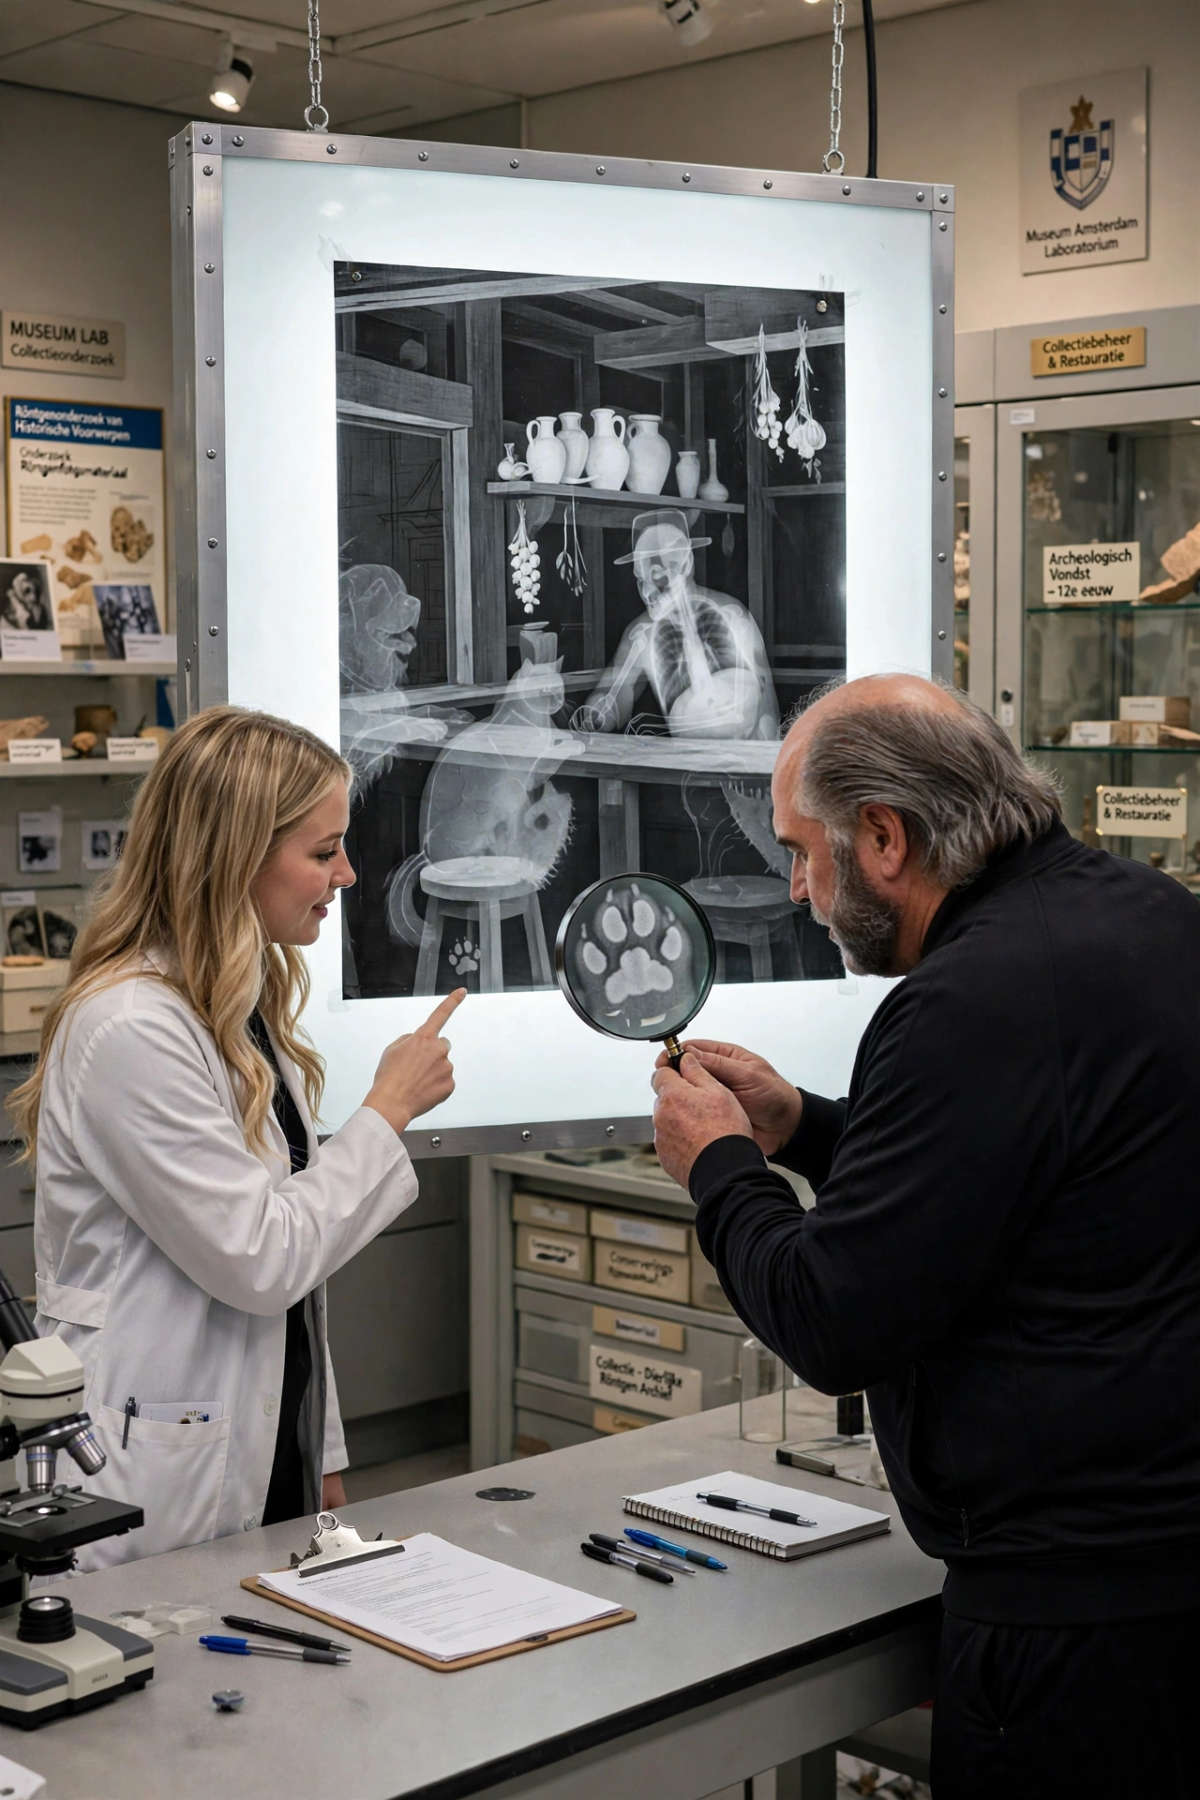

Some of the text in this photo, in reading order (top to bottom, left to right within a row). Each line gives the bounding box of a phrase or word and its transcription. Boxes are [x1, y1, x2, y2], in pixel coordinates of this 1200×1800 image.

[1025, 216, 1138, 243] Museum Amsterdam
[1044, 238, 1119, 258] Laboratorium
[10, 320, 109, 345] MUSEUM LAB
[1042, 333, 1132, 354] Collectiebeheer
[1048, 350, 1125, 369] & Restauratie
[1049, 548, 1132, 566] Archeologisch
[1049, 566, 1091, 581] Vondst
[1058, 585, 1078, 597] 12e
[1081, 585, 1114, 597] eeuw
[1103, 792, 1181, 807] Collectiebeheer
[1103, 808, 1171, 822] & Restauratie
[595, 1355, 635, 1376] Collectie
